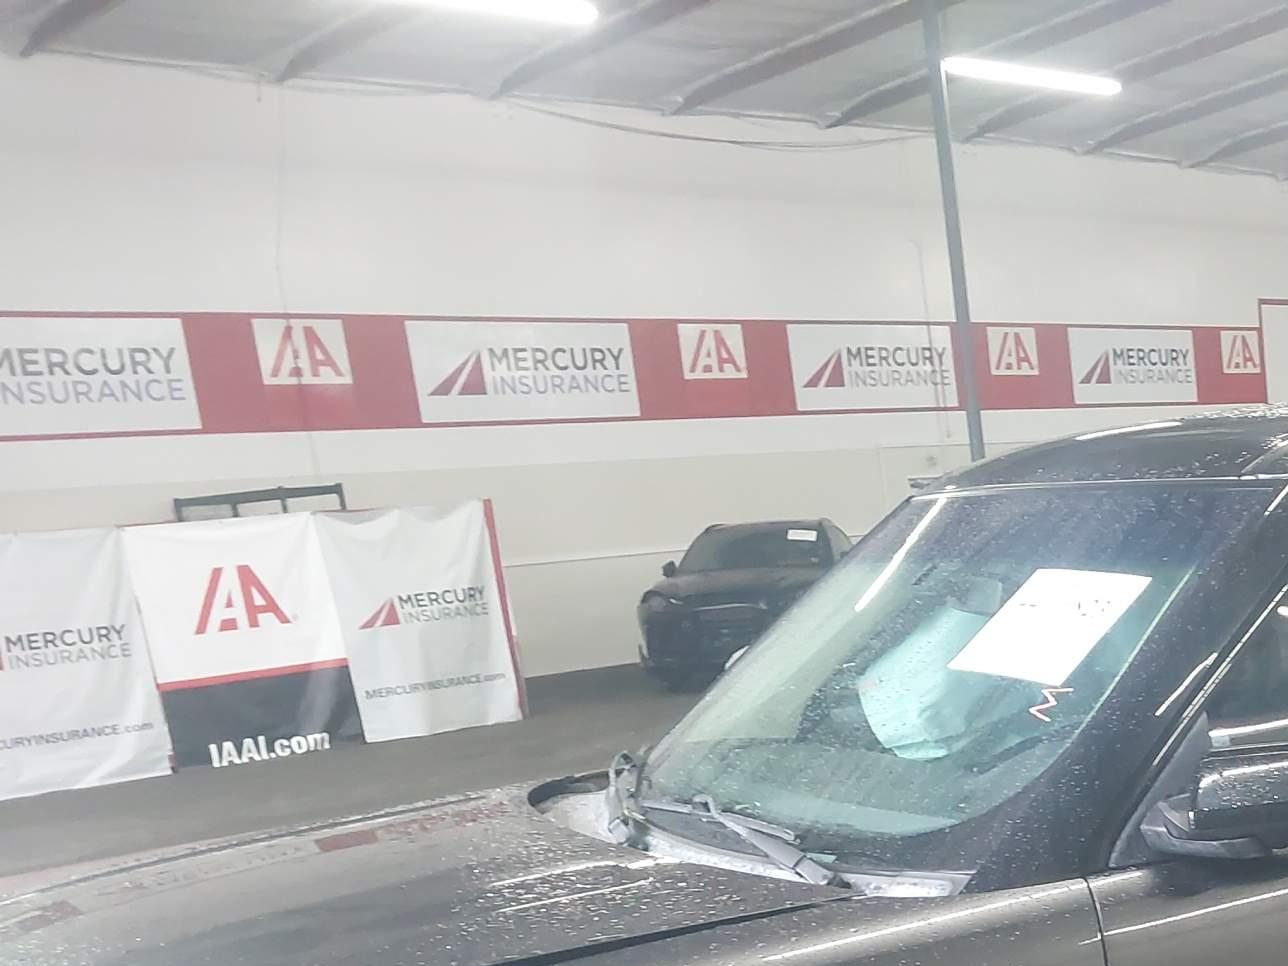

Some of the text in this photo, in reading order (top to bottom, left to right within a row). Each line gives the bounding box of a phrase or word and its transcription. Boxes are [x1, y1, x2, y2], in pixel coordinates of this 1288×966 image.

[487, 347, 625, 372] MERCURY
[846, 346, 947, 368] MERCURY
[1111, 347, 1190, 367] MERCURY
[492, 373, 630, 395] INSURANCE
[849, 369, 951, 388] INSURANCE
[1114, 368, 1193, 384] INSURANCE
[0, 378, 187, 404] NSURANCE
[397, 585, 486, 610] MERCURY
[402, 602, 489, 624] INSURANCE
[4, 624, 127, 652] MERCURY
[8, 642, 133, 670] INSURANCE
[0, 722, 155, 750] CURYINSURANCE.com
